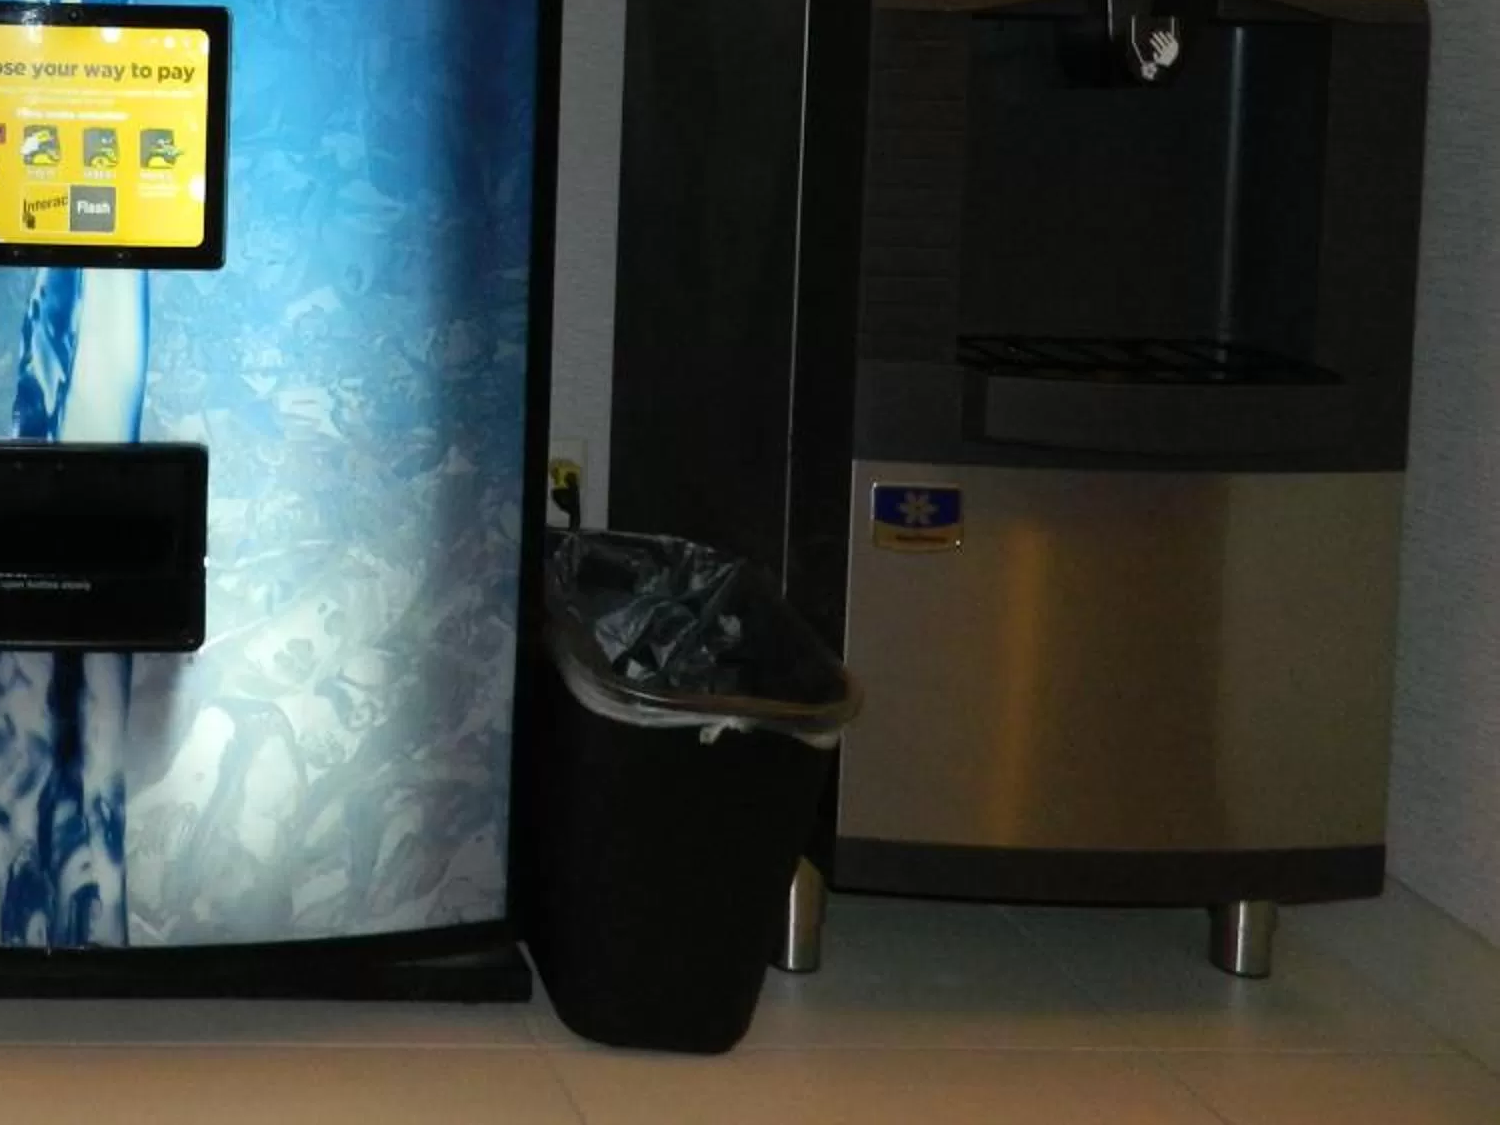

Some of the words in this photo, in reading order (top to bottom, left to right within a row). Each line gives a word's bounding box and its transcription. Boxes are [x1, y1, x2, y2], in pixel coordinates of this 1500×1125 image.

[31, 61, 79, 80] your
[83, 63, 125, 82] way
[131, 62, 153, 80] to
[157, 64, 196, 83] pay
[76, 199, 111, 215] Flash
